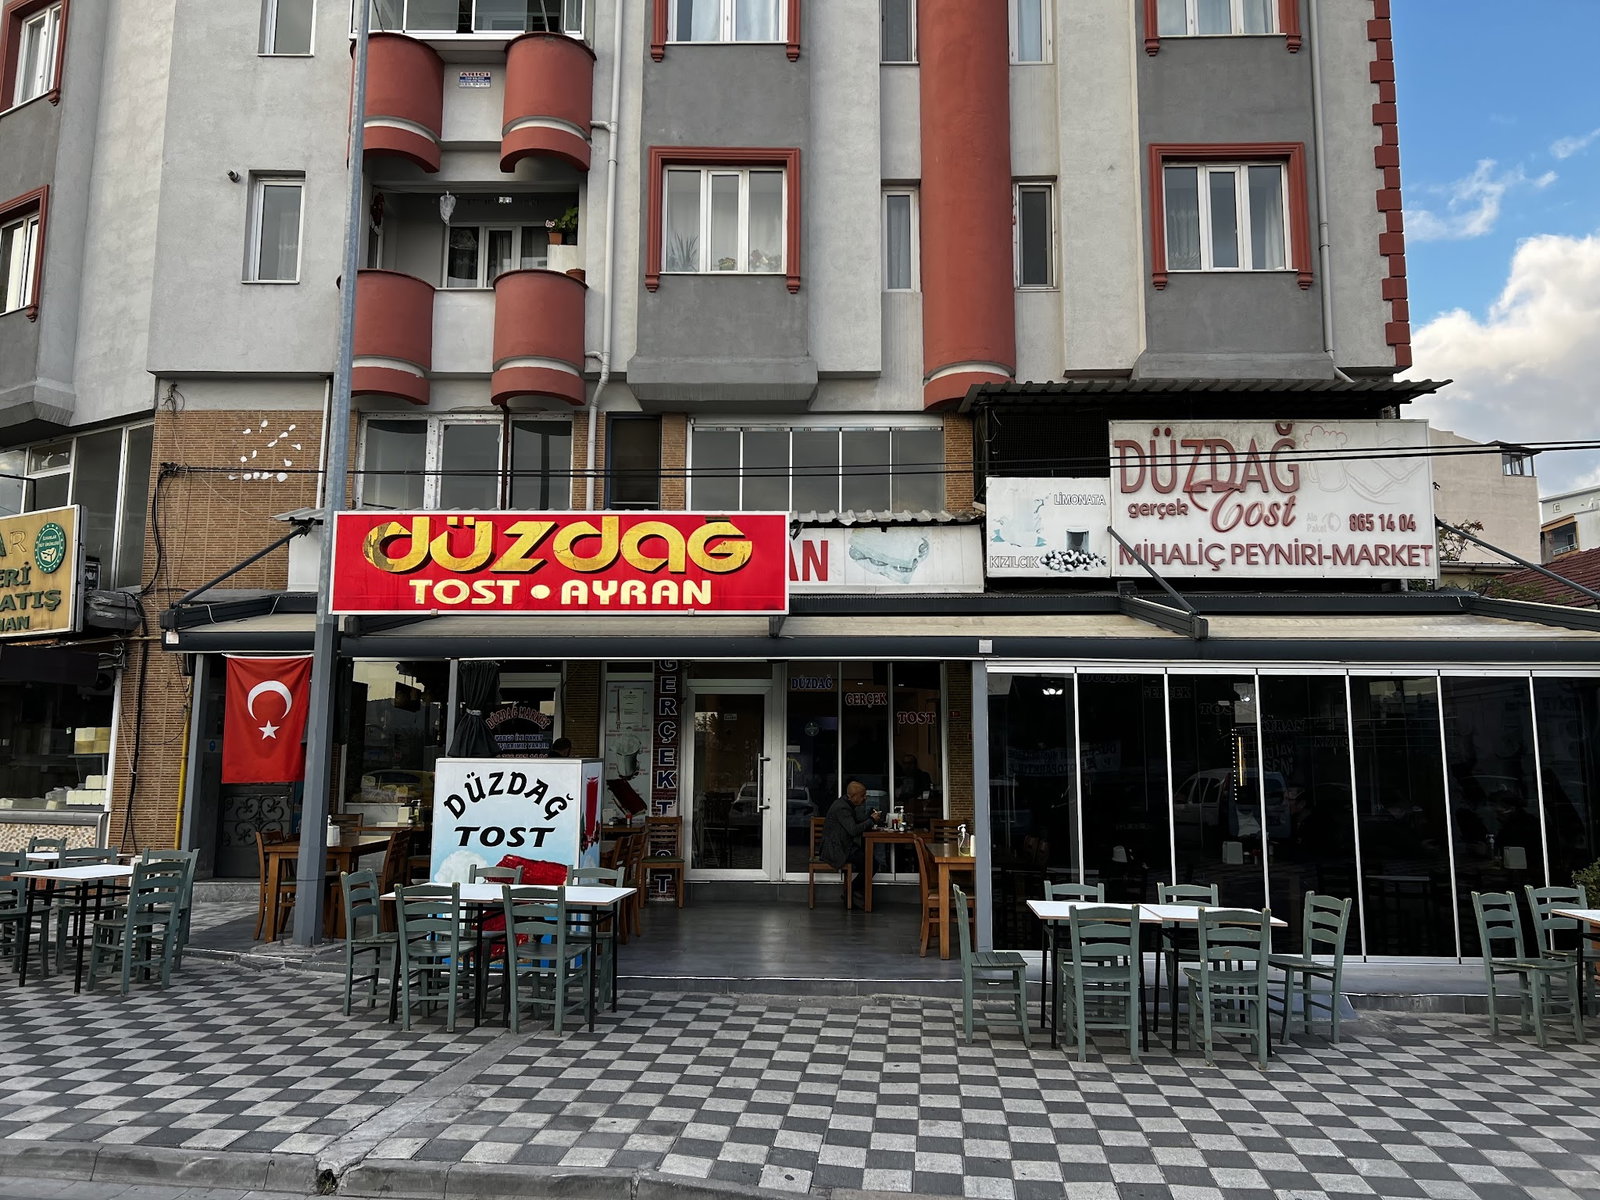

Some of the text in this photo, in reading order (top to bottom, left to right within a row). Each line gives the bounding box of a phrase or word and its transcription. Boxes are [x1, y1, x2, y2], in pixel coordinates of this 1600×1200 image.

[1114, 421, 1300, 494] DÜZDAĞ
[1053, 492, 1107, 506] LİMONATA
[1128, 498, 1189, 519] gerçek
[1349, 513, 1375, 532] 865
[1379, 513, 1396, 532] 14
[1399, 513, 1417, 532] 04
[989, 555, 1040, 569] KIZILCIK
[1119, 538, 1226, 571] MİHALİÇ
[409, 579, 712, 605] TOST AYRAN
[791, 674, 833, 690] DÜZDAĞ
[845, 692, 888, 709] GERÇEK
[897, 711, 937, 726] TOST
[443, 771, 574, 821] DÜZDAĞ
[454, 826, 556, 848] TOST
